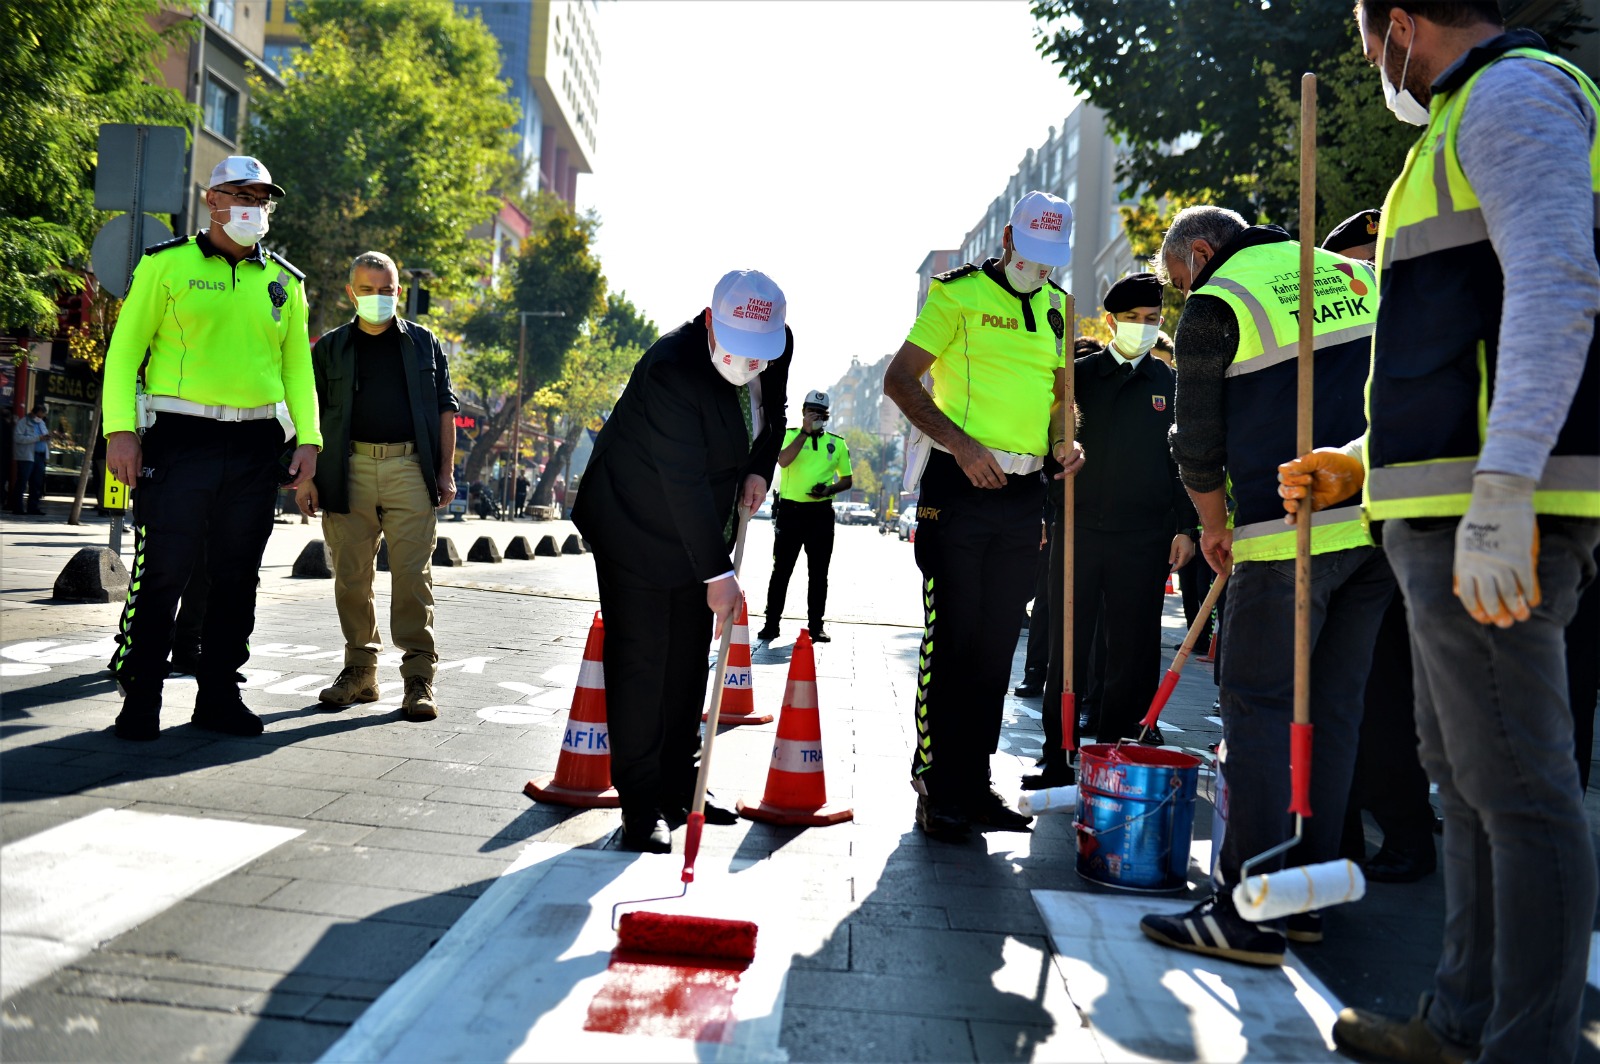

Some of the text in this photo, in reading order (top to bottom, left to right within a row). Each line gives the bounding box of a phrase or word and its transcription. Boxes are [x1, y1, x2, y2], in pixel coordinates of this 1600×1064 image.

[1272, 275, 1344, 296] Kahramaraş
[1278, 283, 1349, 305] Büyük Belediyesi
[746, 303, 772, 316] KIRMIZI
[749, 297, 773, 308] YAYALAR
[48, 374, 83, 398] SENA
[563, 727, 608, 749] AFİK
[800, 749, 823, 763] TRA
